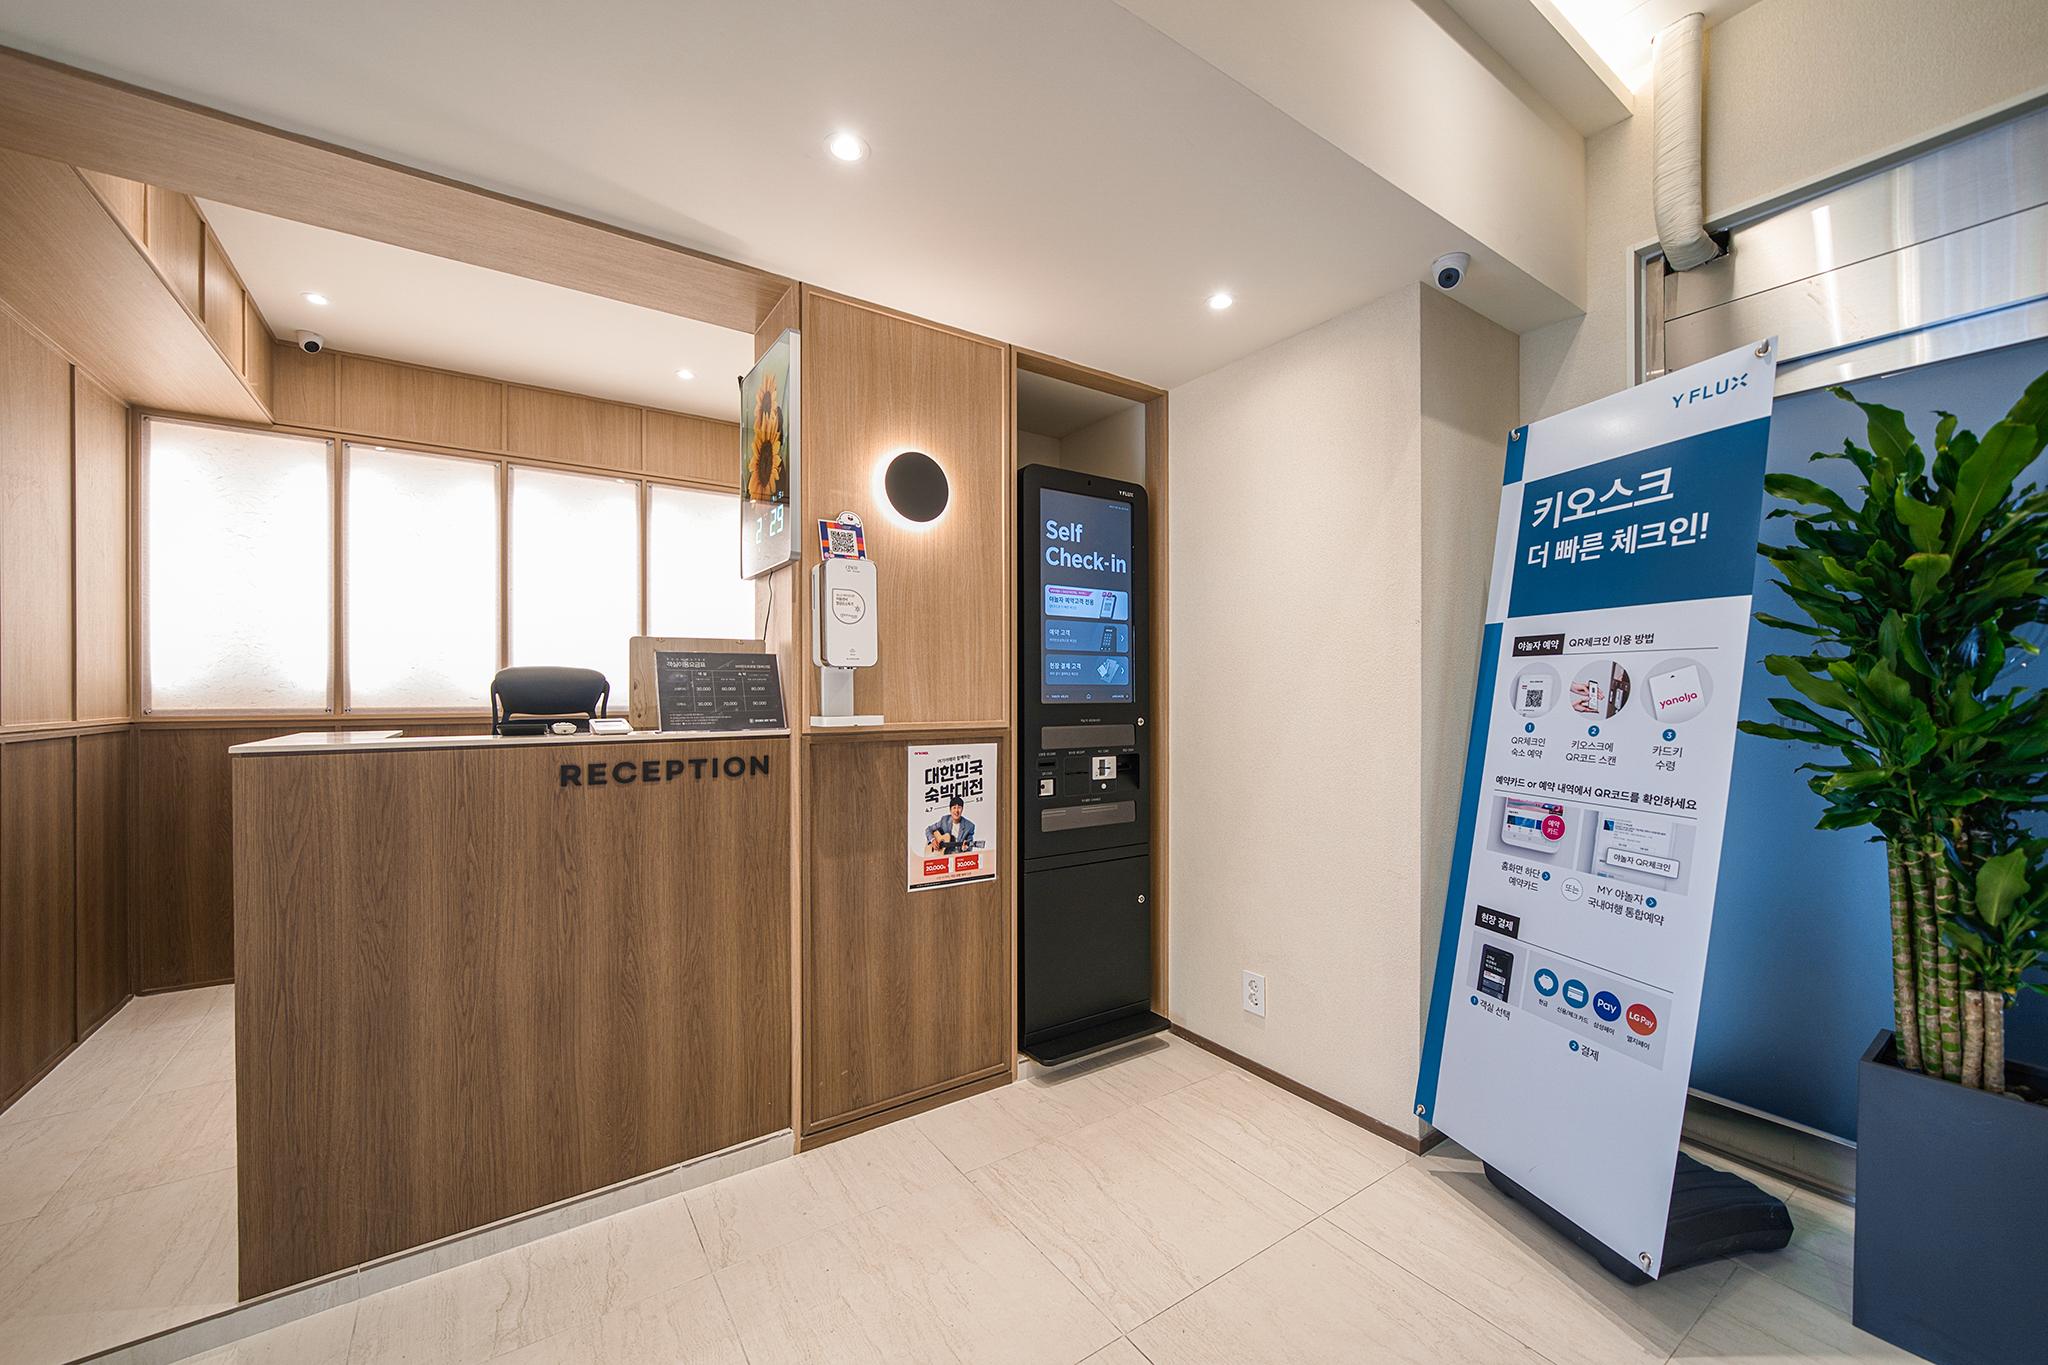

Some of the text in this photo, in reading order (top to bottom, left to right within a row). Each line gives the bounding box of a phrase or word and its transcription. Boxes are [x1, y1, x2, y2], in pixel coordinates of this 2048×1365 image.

[1530, 467, 1675, 529] 키오스크
[1045, 519, 1083, 544] Self
[1526, 511, 1711, 569] 더 빠른 체크인!
[1045, 546, 1128, 575] Check-in
[1517, 639, 1560, 651] 야놀자 예약
[1568, 633, 1655, 648] QR체크인 이용 방법
[1659, 690, 1698, 710] yanolja
[1511, 736, 1546, 747] QR체크인
[1571, 740, 1614, 752] 키오스크에
[1652, 745, 1683, 758] 카드키
[1511, 748, 1543, 759] 숙소 예약
[1565, 753, 1617, 767] QR코드 스캔
[560, 755, 770, 787] RECEPTION
[925, 759, 984, 785] 대한민국
[1655, 759, 1676, 772] 수령
[925, 778, 984, 804] 숙박대전
[1495, 775, 1698, 811] 예약카드 or 예약 내역에서 QR코드를 확인하세요
[1501, 861, 1541, 879] 홈화면 하단
[1613, 853, 1671, 873] 야놀자 QR체크인
[1508, 876, 1539, 892] 예약카드
[1564, 882, 1579, 895] 또는
[1596, 885, 1644, 905] MY 야놀자
[1587, 897, 1665, 926] 국내여행 통합예약
[1481, 912, 1515, 932] 현장 결제
[1480, 999, 1496, 1015] 객실
[1496, 1005, 1511, 1021] 선택
[1629, 1011, 1655, 1029] LG Pay
[1581, 1044, 1599, 1062] 결제
